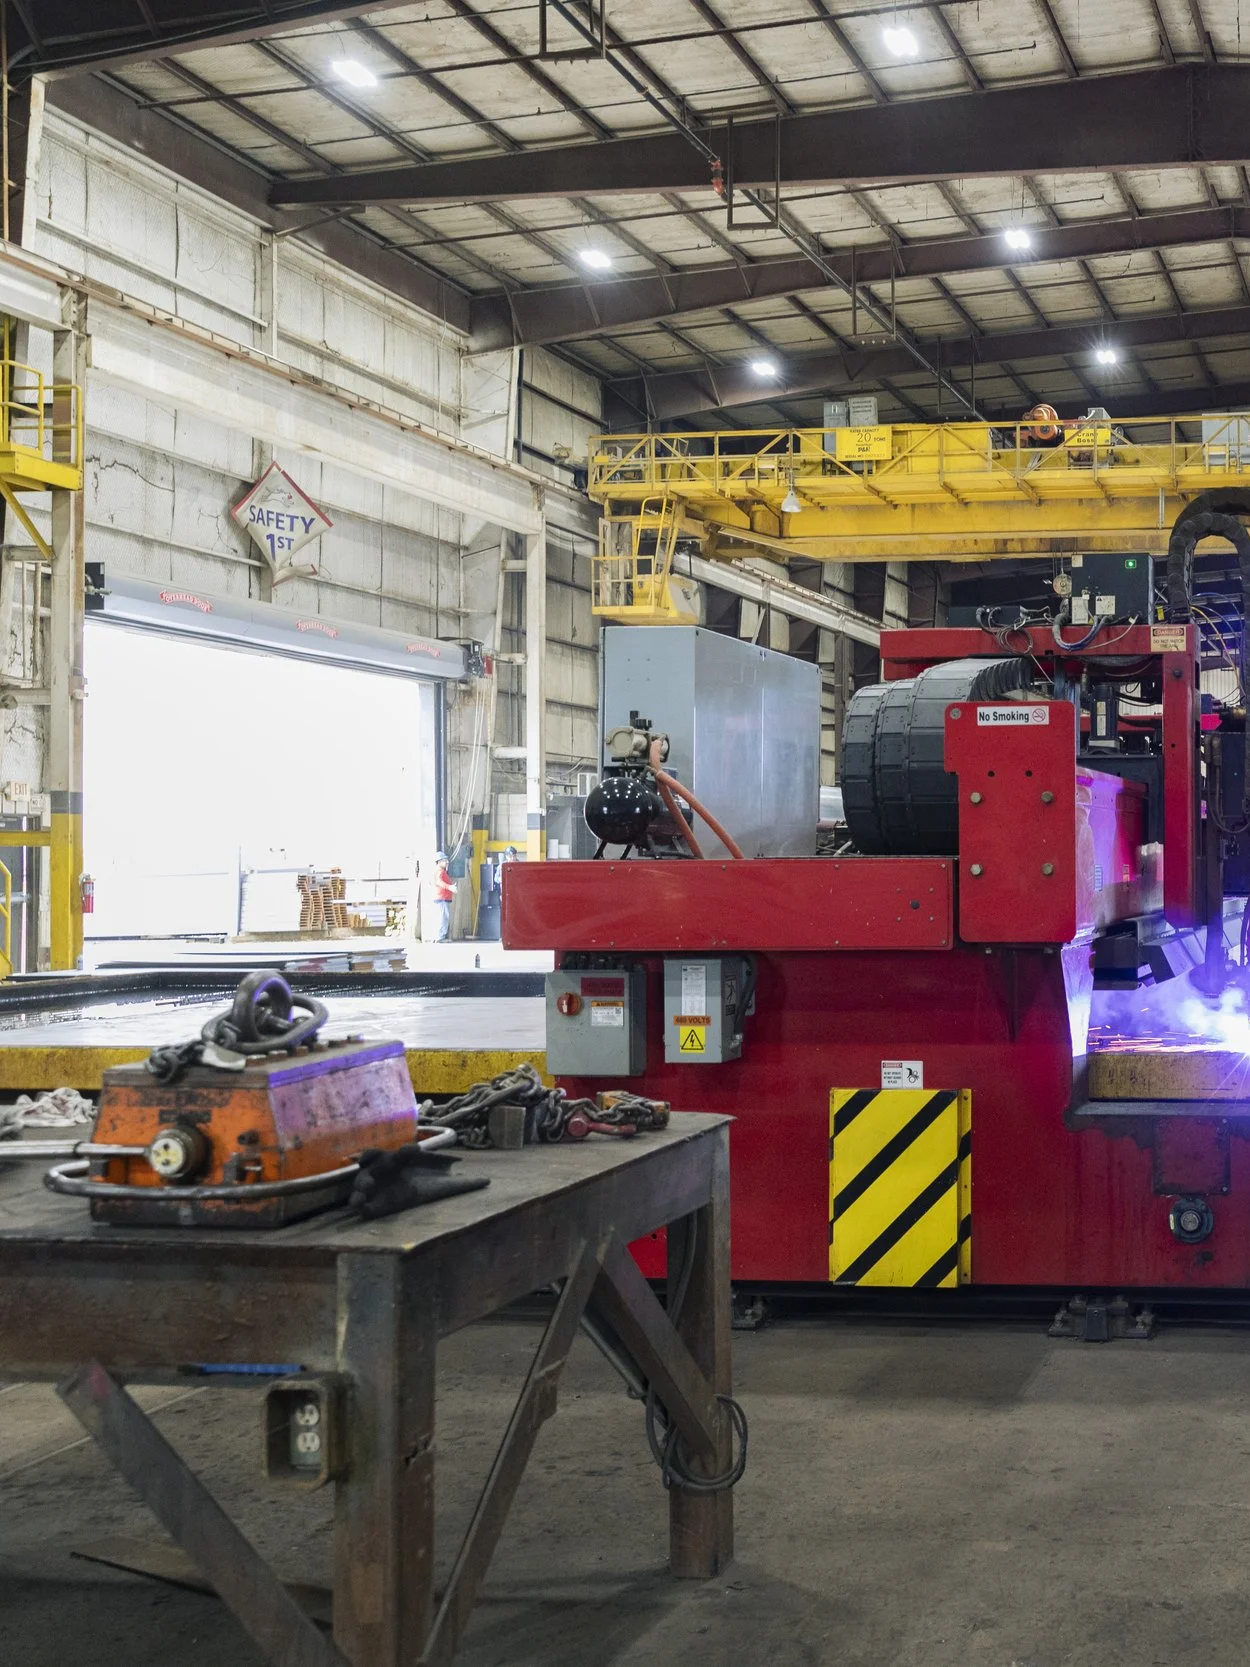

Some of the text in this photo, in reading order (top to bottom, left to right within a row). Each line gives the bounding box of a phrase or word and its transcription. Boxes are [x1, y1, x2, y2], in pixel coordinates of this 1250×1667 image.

[856, 432, 872, 443] 20
[248, 505, 317, 534] SAFETY
[266, 533, 295, 561] 1ST
[978, 711, 1030, 723] No Smoking
[15, 783, 28, 796] EXIT
[688, 1016, 711, 1024] VOLTS
